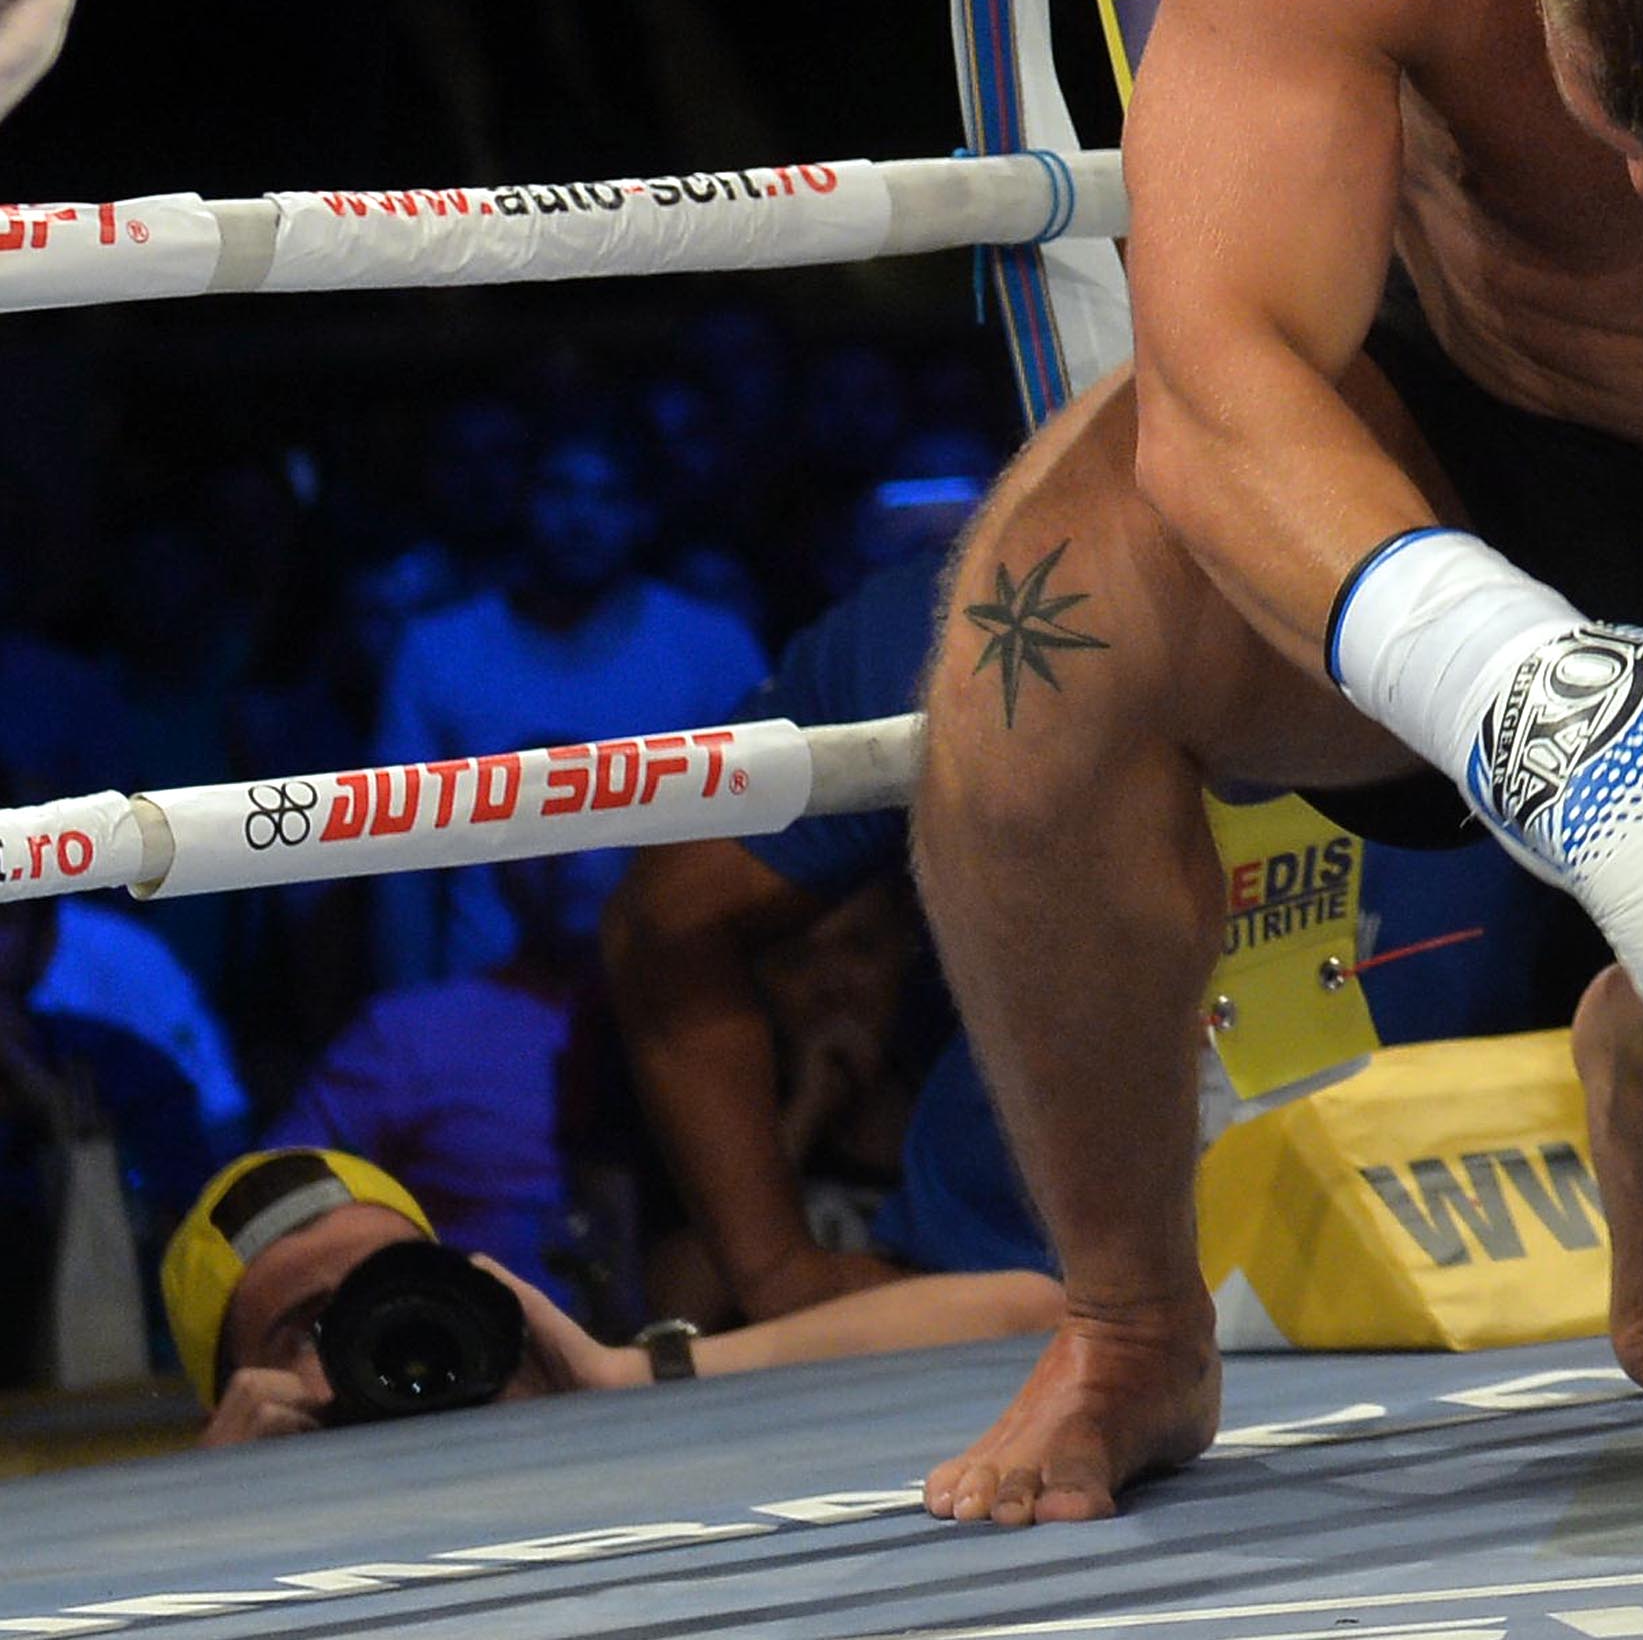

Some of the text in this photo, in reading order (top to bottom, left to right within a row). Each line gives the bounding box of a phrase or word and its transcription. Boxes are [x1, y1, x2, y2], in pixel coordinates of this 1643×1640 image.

[319, 730, 736, 843] AUTO SOFT
[1226, 836, 1354, 912] EDIS
